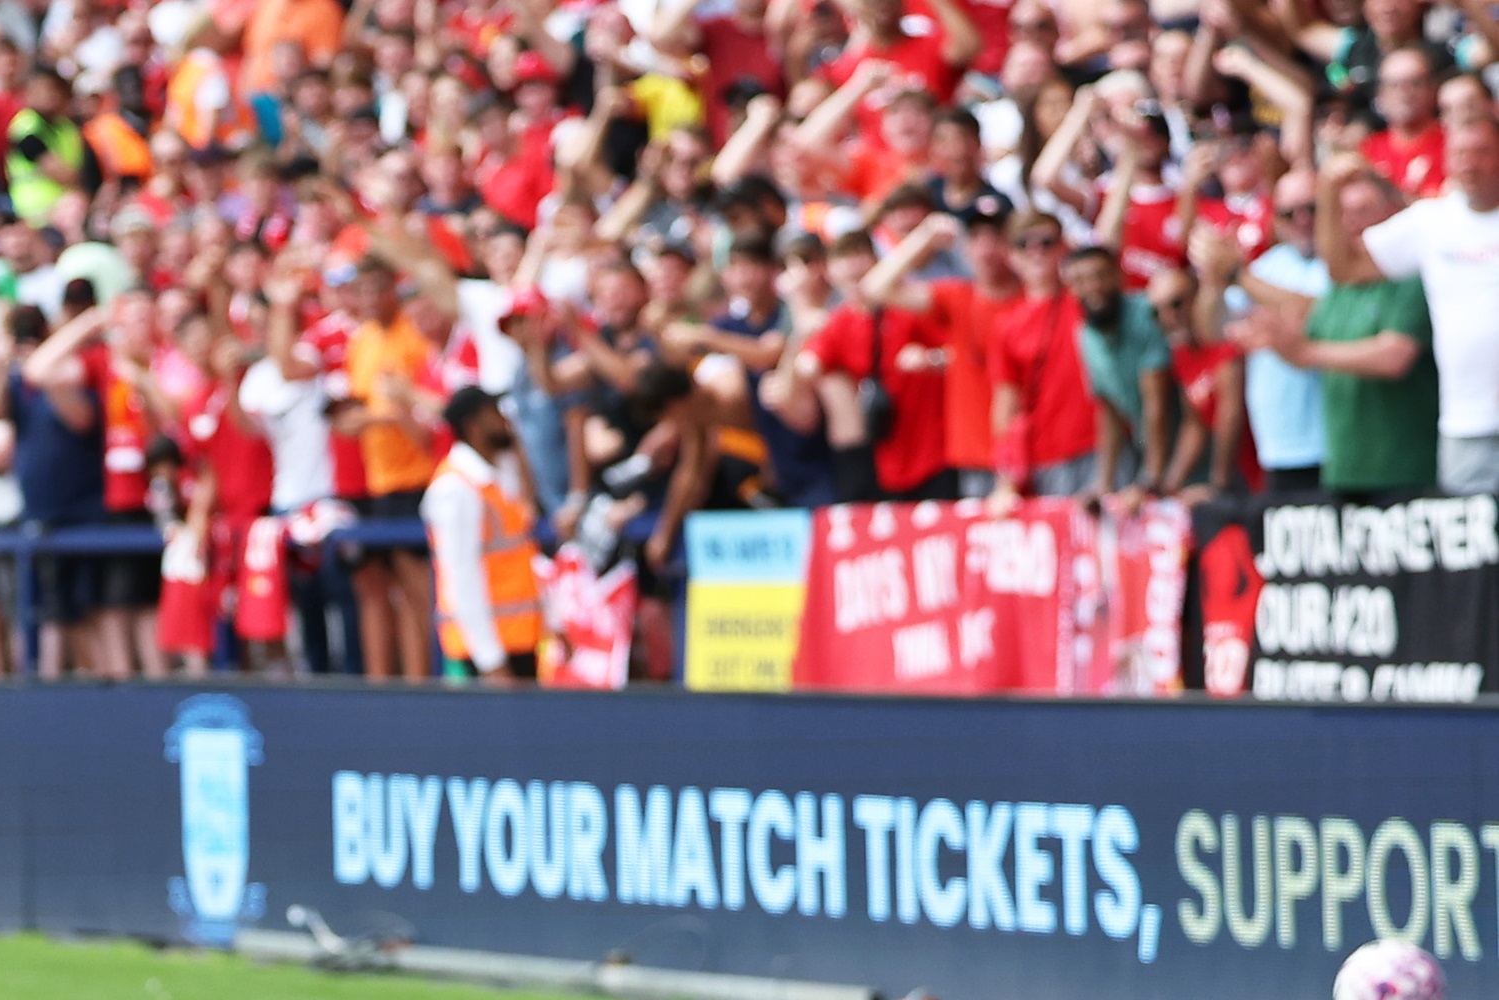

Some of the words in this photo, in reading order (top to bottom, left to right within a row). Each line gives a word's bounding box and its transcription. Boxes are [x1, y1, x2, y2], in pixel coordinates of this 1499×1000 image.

[1255, 504, 1341, 578] JOTA
[1255, 582, 1331, 655] OUR
[332, 769, 444, 890] BUY
[446, 776, 609, 902] YOUR
[614, 783, 847, 919] MATCH
[853, 794, 1163, 964] TICKETS,
